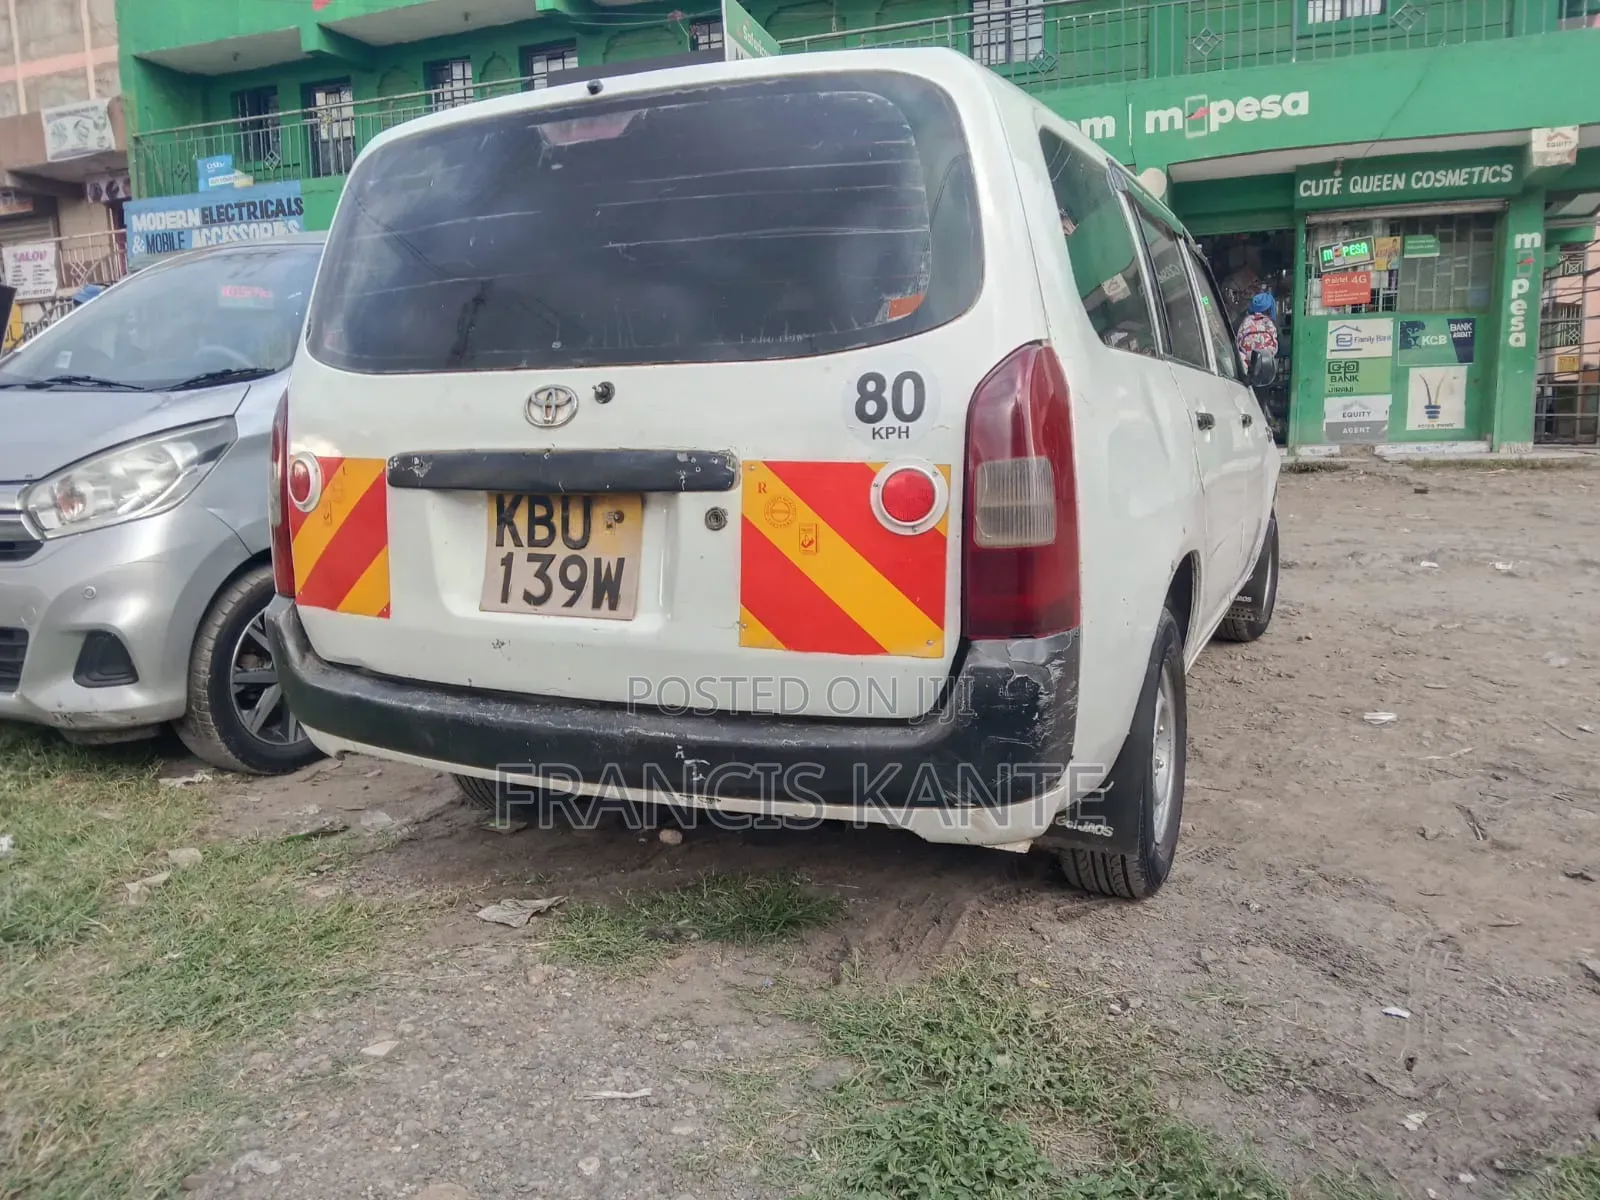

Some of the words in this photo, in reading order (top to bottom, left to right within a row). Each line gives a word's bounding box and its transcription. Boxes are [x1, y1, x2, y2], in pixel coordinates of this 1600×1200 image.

[1300, 177, 1342, 197] CUTE
[1350, 173, 1405, 194] QUEEN
[1411, 164, 1514, 189] COSMETICS
[131, 207, 200, 232] MODERN
[201, 197, 304, 225] ELECTRICALS
[133, 235, 145, 254] &
[145, 231, 185, 254] MOBILE
[1351, 275, 1368, 284] 4G
[1450, 323, 1472, 332] BANK
[1354, 335, 1375, 345] Family
[1421, 334, 1448, 346] KCB
[1331, 375, 1360, 383] BANK
[855, 370, 926, 424] 80
[872, 426, 910, 440] KPH
[496, 493, 592, 550] KBU
[500, 552, 625, 611] 139W
